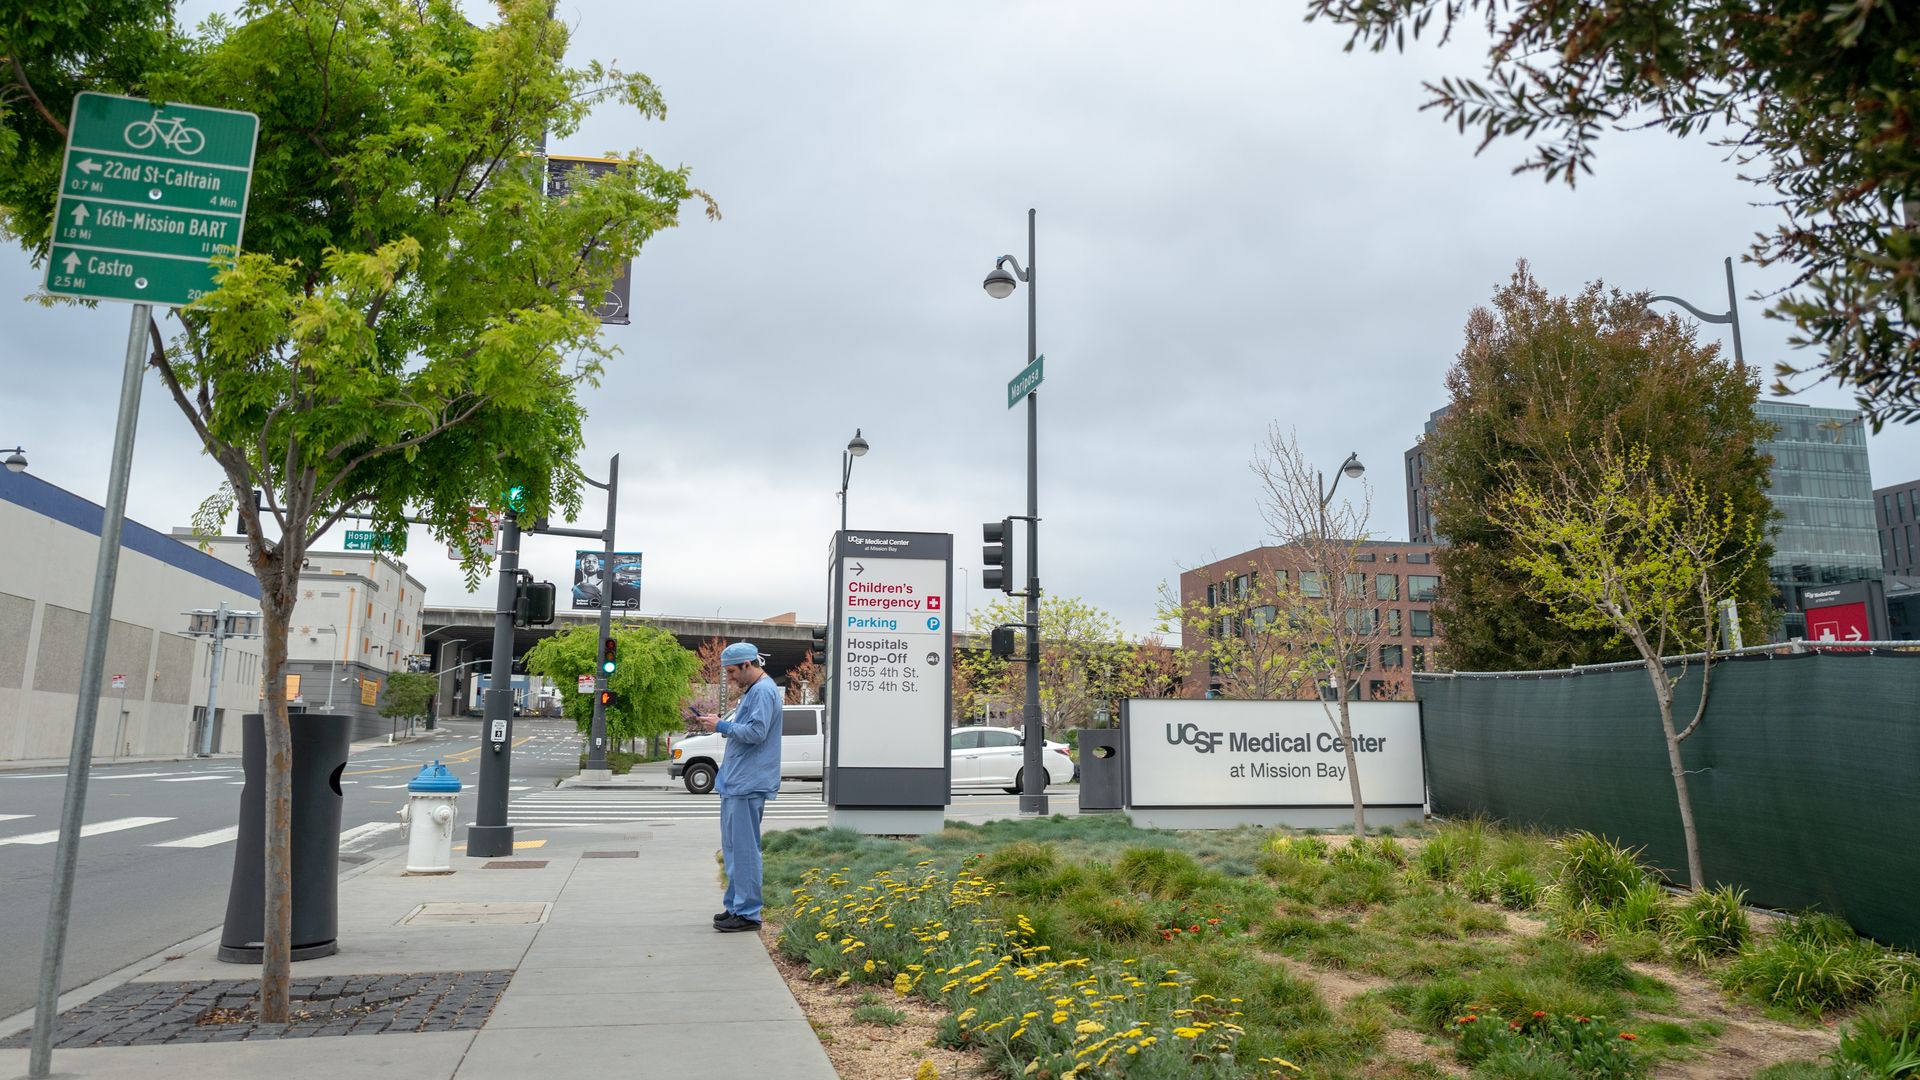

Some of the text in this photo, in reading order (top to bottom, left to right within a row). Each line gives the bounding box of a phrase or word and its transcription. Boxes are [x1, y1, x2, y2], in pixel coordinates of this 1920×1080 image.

[103, 161, 221, 190] 22nd St-Caltrain
[71, 179, 103, 192] 0.7 Mi
[210, 196, 237, 208] 4 Min
[96, 209, 228, 239] 16th-Mission BART
[63, 228, 91, 240] 1.8 Mi
[212, 243, 230, 254] Min
[88, 256, 134, 277] Castro
[54, 276, 86, 289] 2.5 Mi
[1011, 369, 1039, 400] Mariposa
[848, 536, 864, 544] UCSF
[848, 582, 913, 594] Children's
[848, 596, 920, 610] Emergency
[848, 617, 897, 630] Parking
[847, 638, 908, 651] Hospitals
[847, 652, 908, 665] Drop-Off
[848, 667, 919, 678] 1855 4th St.
[847, 681, 918, 692] 1975 4th St.
[1166, 722, 1386, 753] UCSF Medical Center
[1230, 762, 1347, 781] at Mission Bay
